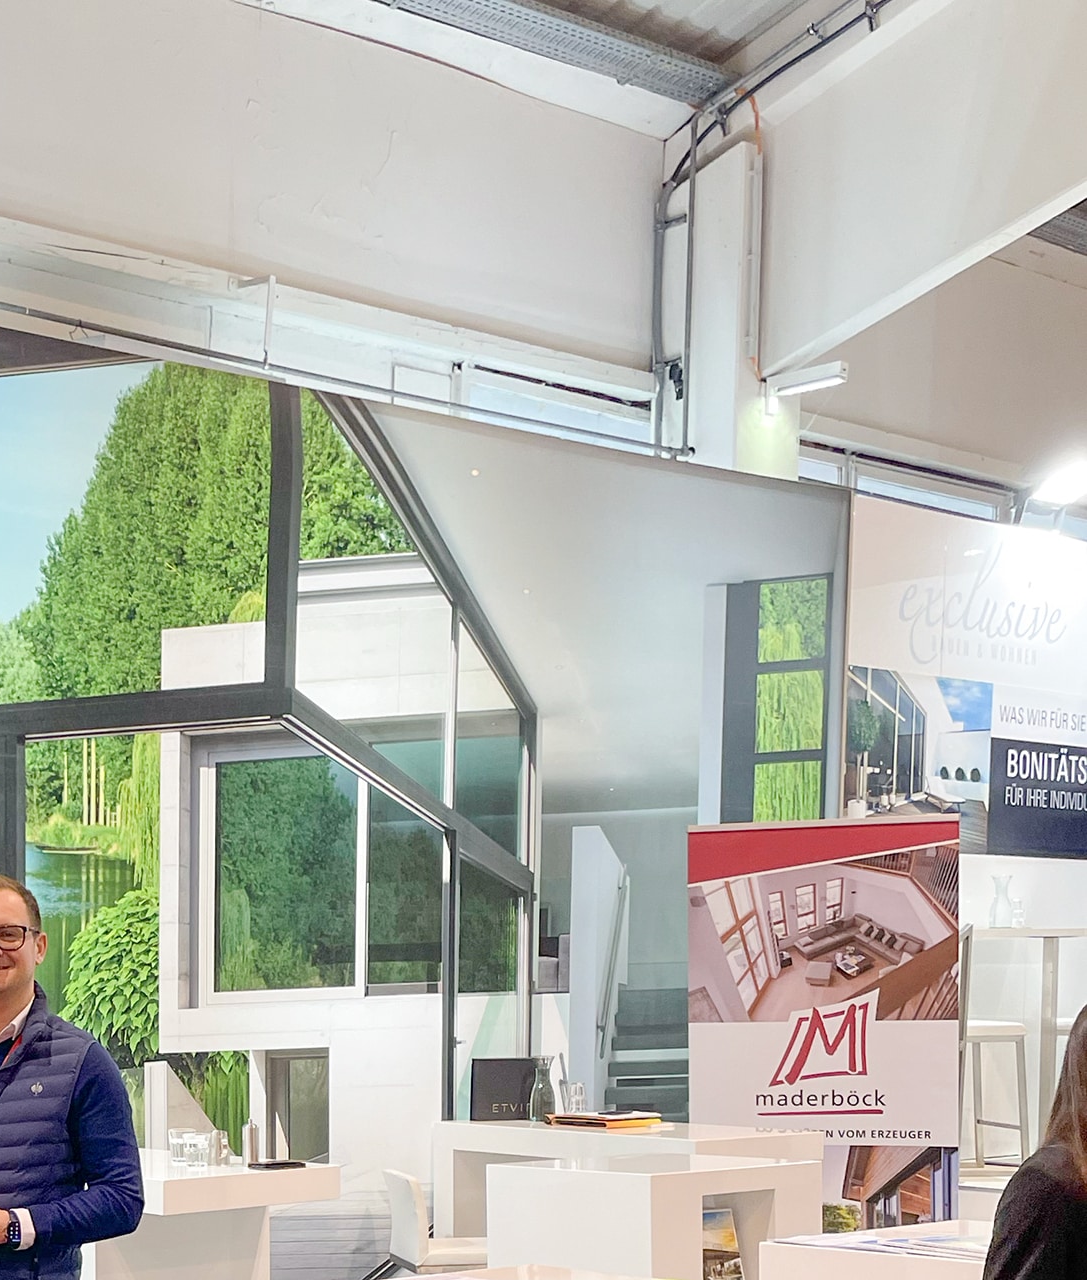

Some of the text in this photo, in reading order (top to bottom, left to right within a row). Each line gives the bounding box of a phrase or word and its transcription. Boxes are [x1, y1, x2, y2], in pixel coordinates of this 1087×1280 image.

[899, 538, 1067, 665] exclusive
[999, 705, 1087, 732] WAS WIR FÜR SIE
[1006, 747, 1087, 785] BONITÄTS
[1004, 783, 1024, 806] FÜR
[1026, 788, 1048, 808] IHRE
[755, 1089, 886, 1107] maderböck
[838, 1129, 866, 1139] VOM
[871, 1129, 931, 1140] ERZEUGER
